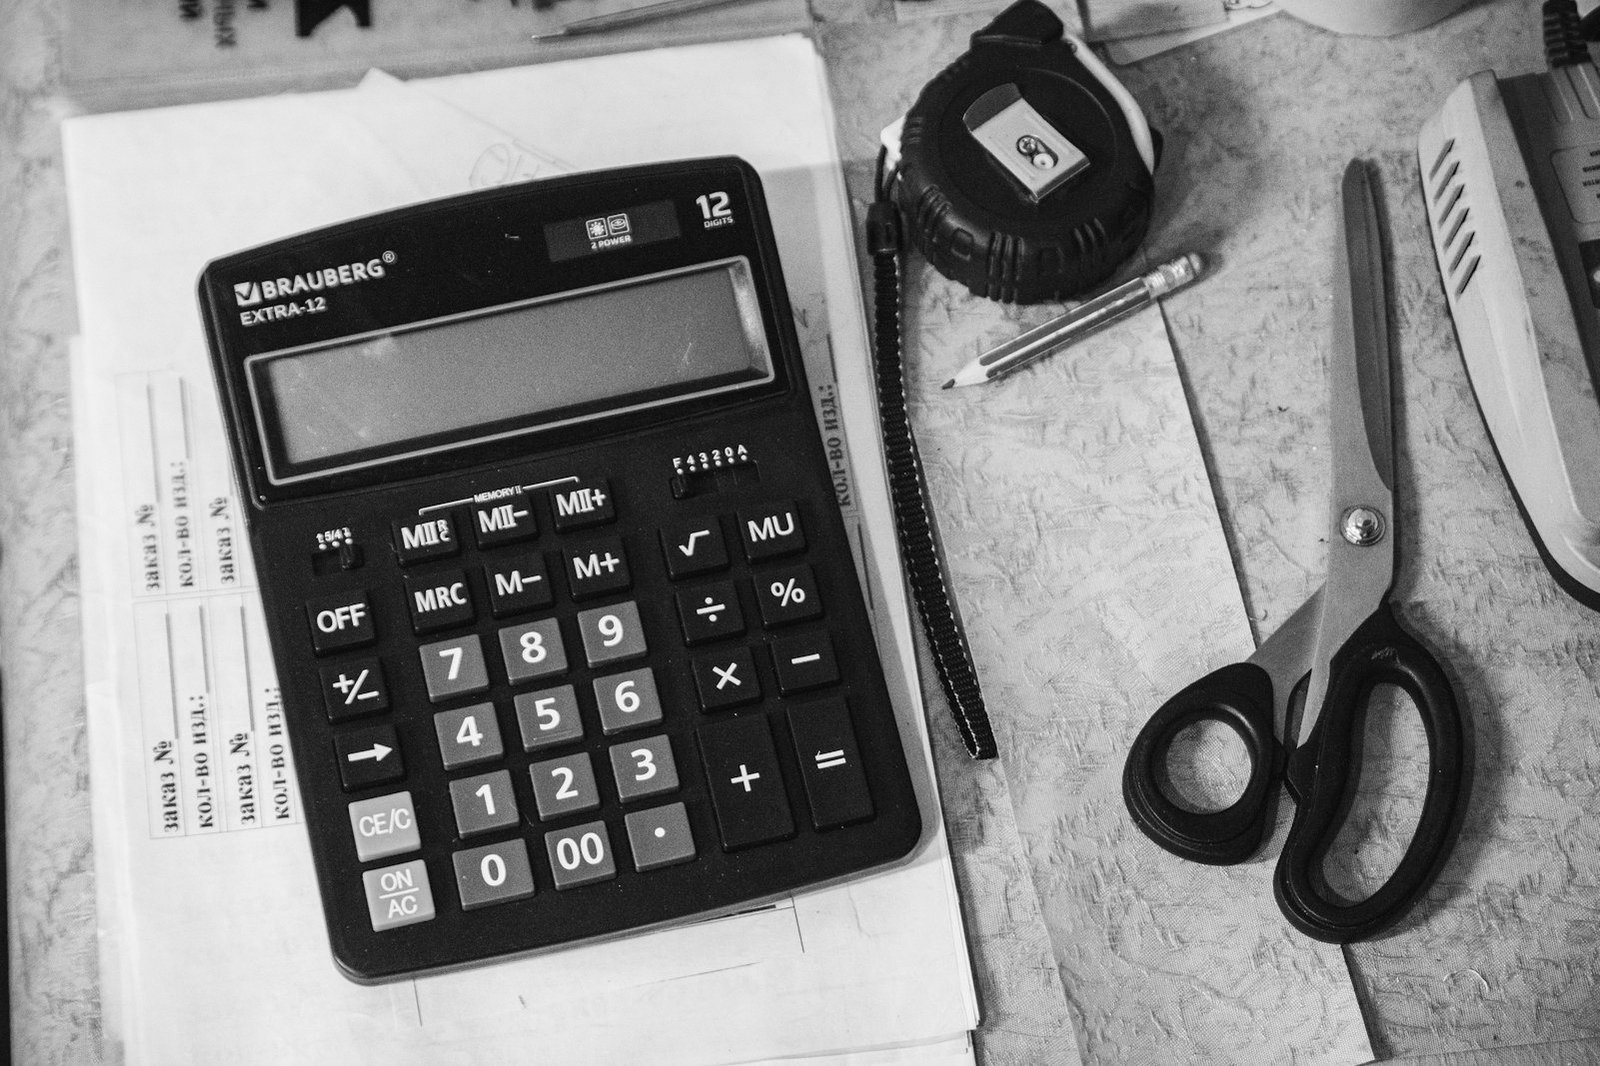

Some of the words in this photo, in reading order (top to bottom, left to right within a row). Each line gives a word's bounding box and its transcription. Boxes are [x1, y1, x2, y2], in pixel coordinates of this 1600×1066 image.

[695, 191, 732, 219] 12
[703, 216, 734, 229] DIGITS
[591, 241, 597, 250] 2
[598, 235, 632, 248] POWER
[239, 296, 328, 326] EXTRA-12
[473, 487, 515, 503] MEMORY
[747, 512, 795, 542] MU
[142, 534, 160, 591] заказ
[174, 516, 193, 588] кол-во
[216, 527, 235, 584] заказ
[572, 552, 620, 580] M+
[414, 582, 467, 613] MRC
[316, 602, 366, 633] OFF
[597, 614, 624, 647] 9
[438, 647, 463, 680] 7
[519, 631, 547, 664] 8
[614, 680, 641, 713] 6
[534, 697, 560, 730] 5
[456, 715, 483, 746] 4
[630, 748, 657, 781] 3
[193, 752, 213, 828] кол-во
[236, 764, 256, 825] заказ
[269, 743, 290, 820] кол-во
[551, 767, 579, 800] 2
[160, 771, 179, 833] заказ
[475, 784, 496, 816] 1
[359, 808, 412, 837] CE/C
[556, 832, 605, 870] 00
[380, 868, 413, 892] ON
[480, 853, 507, 886] 0
[388, 895, 418, 919] AC
